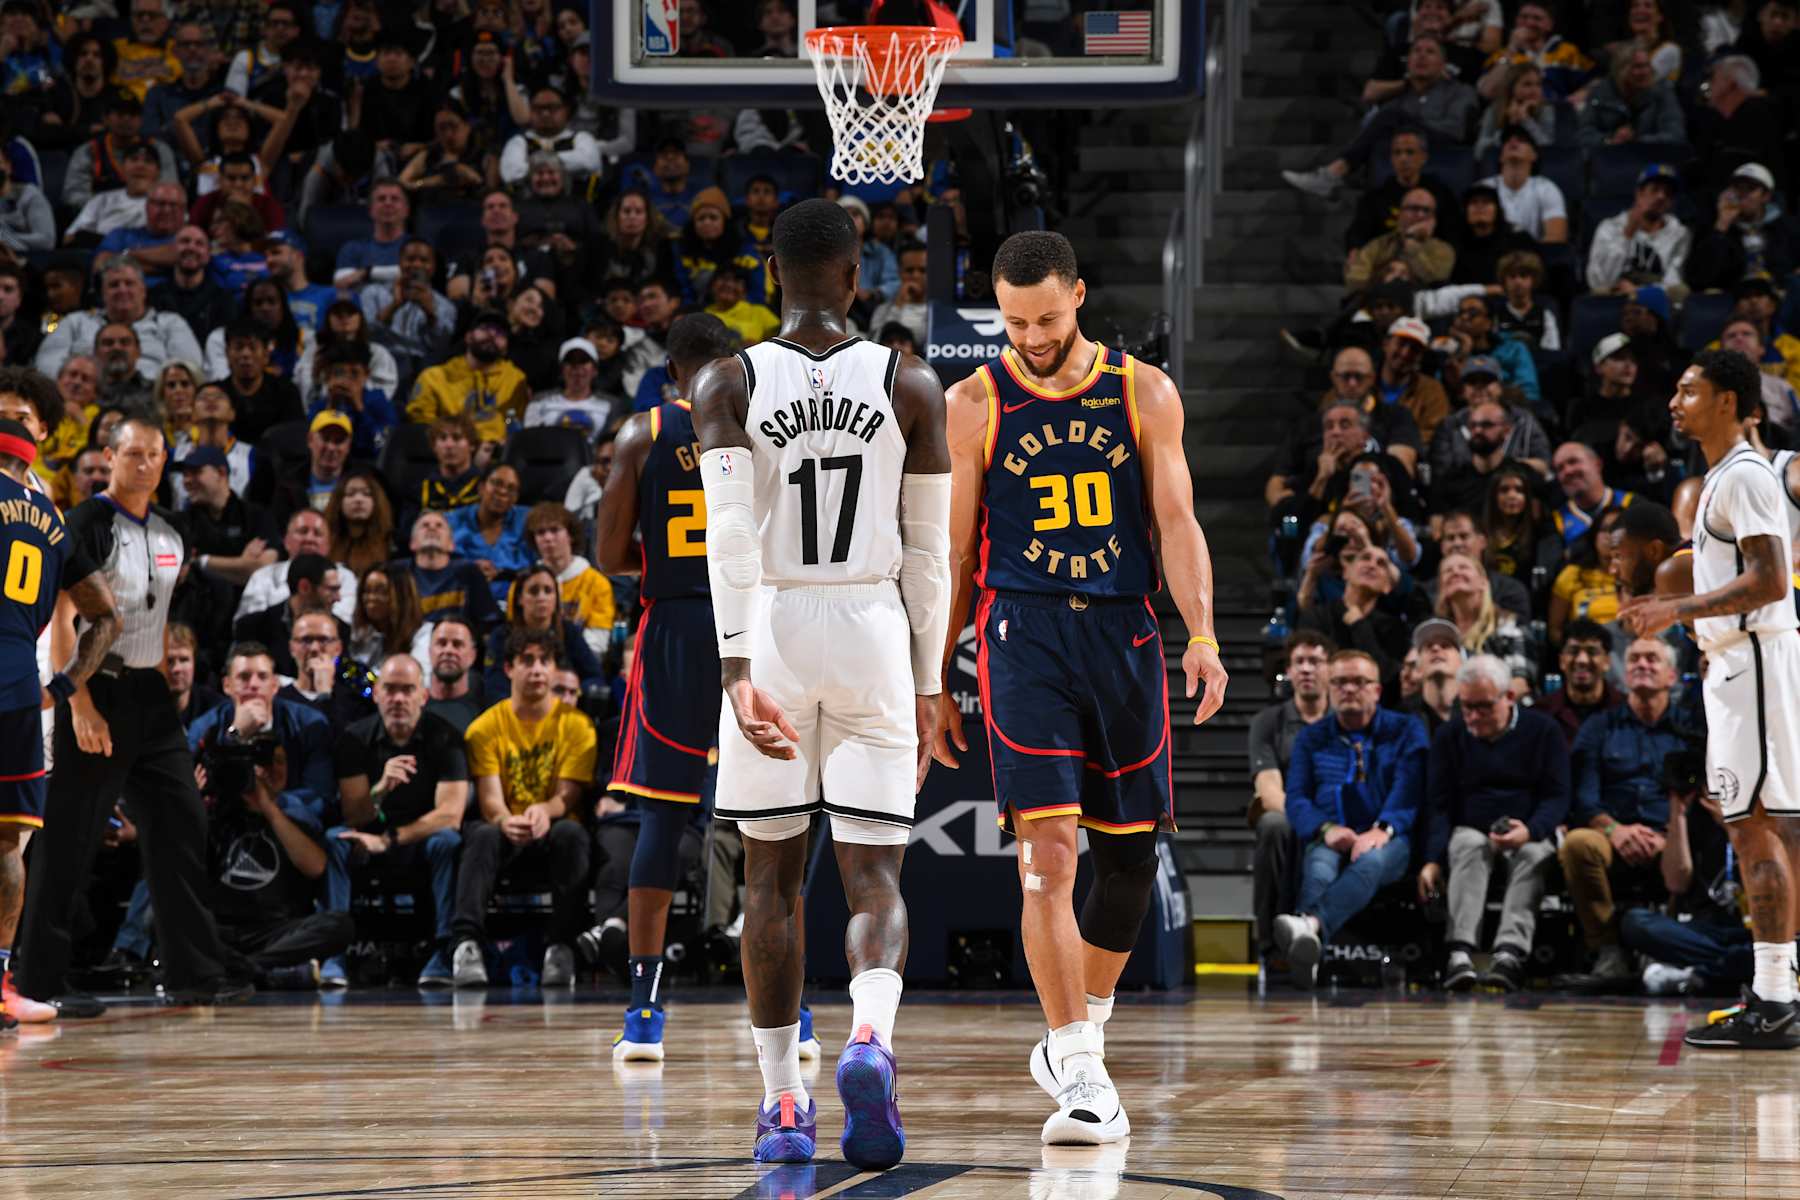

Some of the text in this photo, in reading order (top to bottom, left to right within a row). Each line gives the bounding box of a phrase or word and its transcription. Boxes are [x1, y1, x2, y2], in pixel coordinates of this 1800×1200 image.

[760, 391, 885, 448] SCHRÖDER
[1081, 397, 1120, 409] Rakuten
[1003, 420, 1131, 476] GOLDEN
[0, 499, 52, 534] PAYTON
[788, 454, 863, 565] 17
[1029, 471, 1113, 532] 30
[4, 539, 43, 606] 0
[1022, 534, 1122, 578] STATE
[1323, 944, 1383, 961] CHAS
